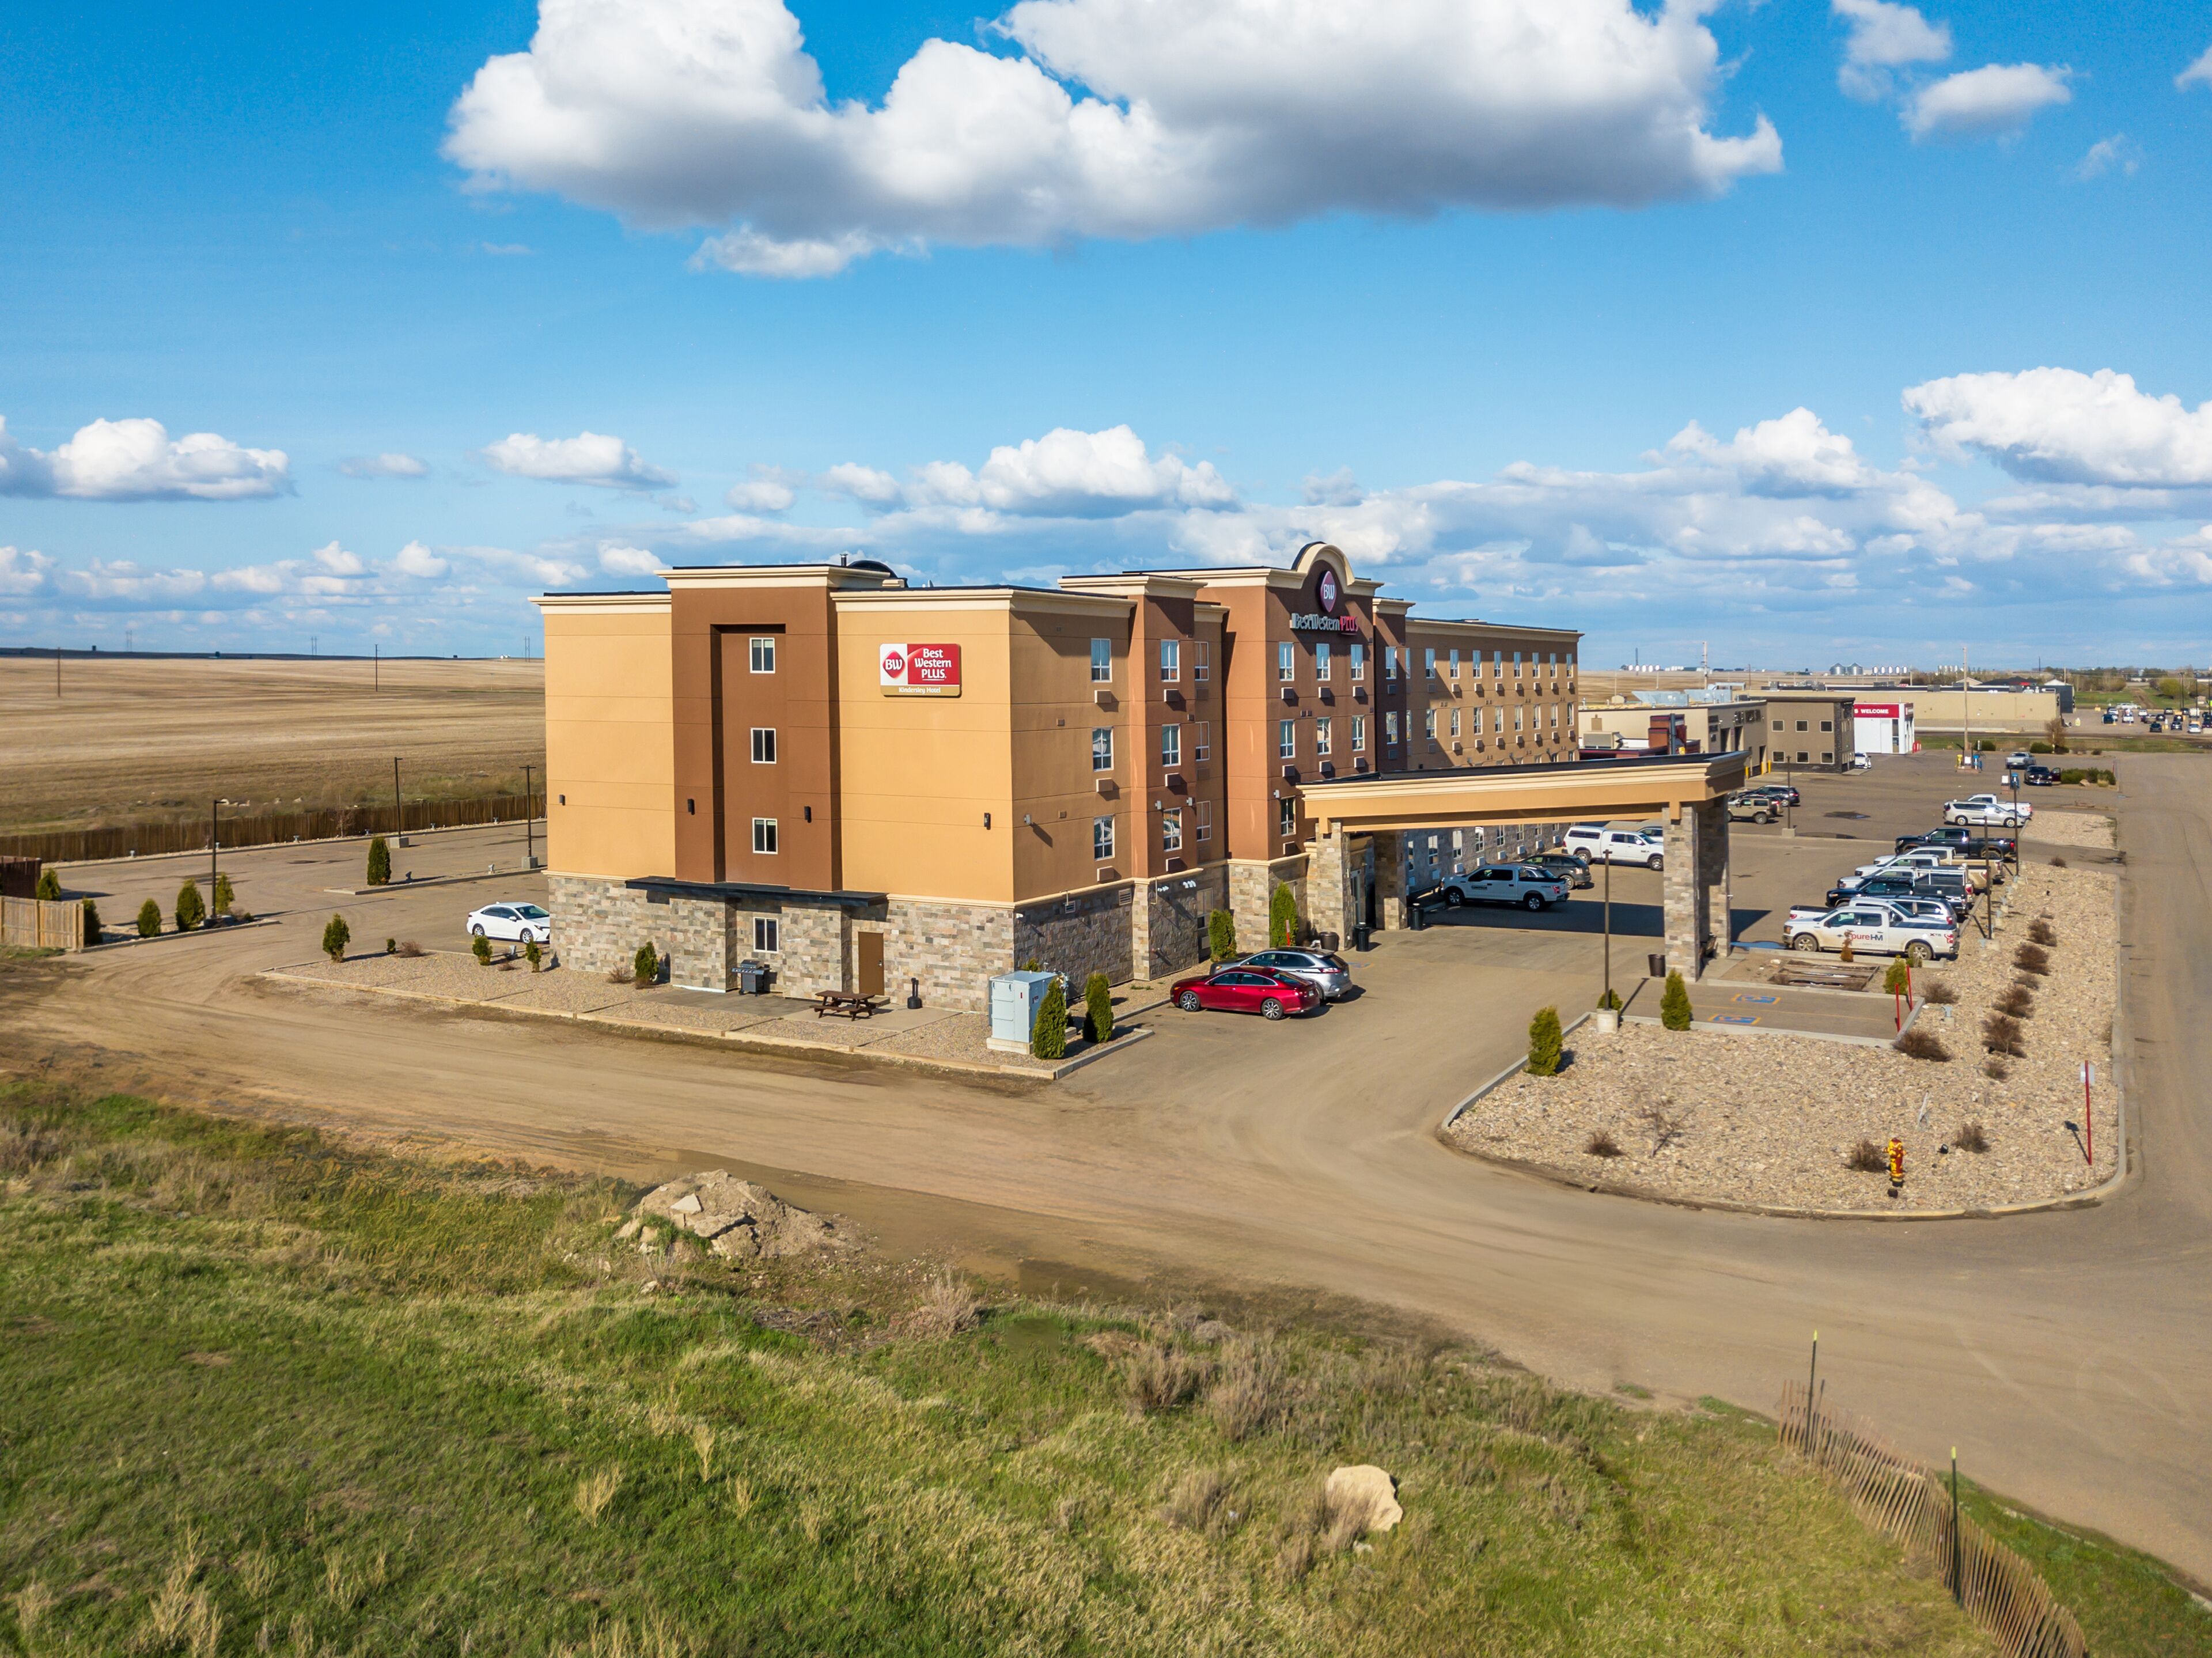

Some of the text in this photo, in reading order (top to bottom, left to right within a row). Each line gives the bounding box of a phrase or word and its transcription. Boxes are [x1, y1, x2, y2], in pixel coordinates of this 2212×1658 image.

[1323, 584, 1335, 600] BW
[1291, 613, 1359, 632] Best Western PLUS
[923, 648, 944, 658] Best
[885, 659, 903, 671] BW
[914, 658, 952, 668] Western
[922, 669, 945, 679] PLUS
